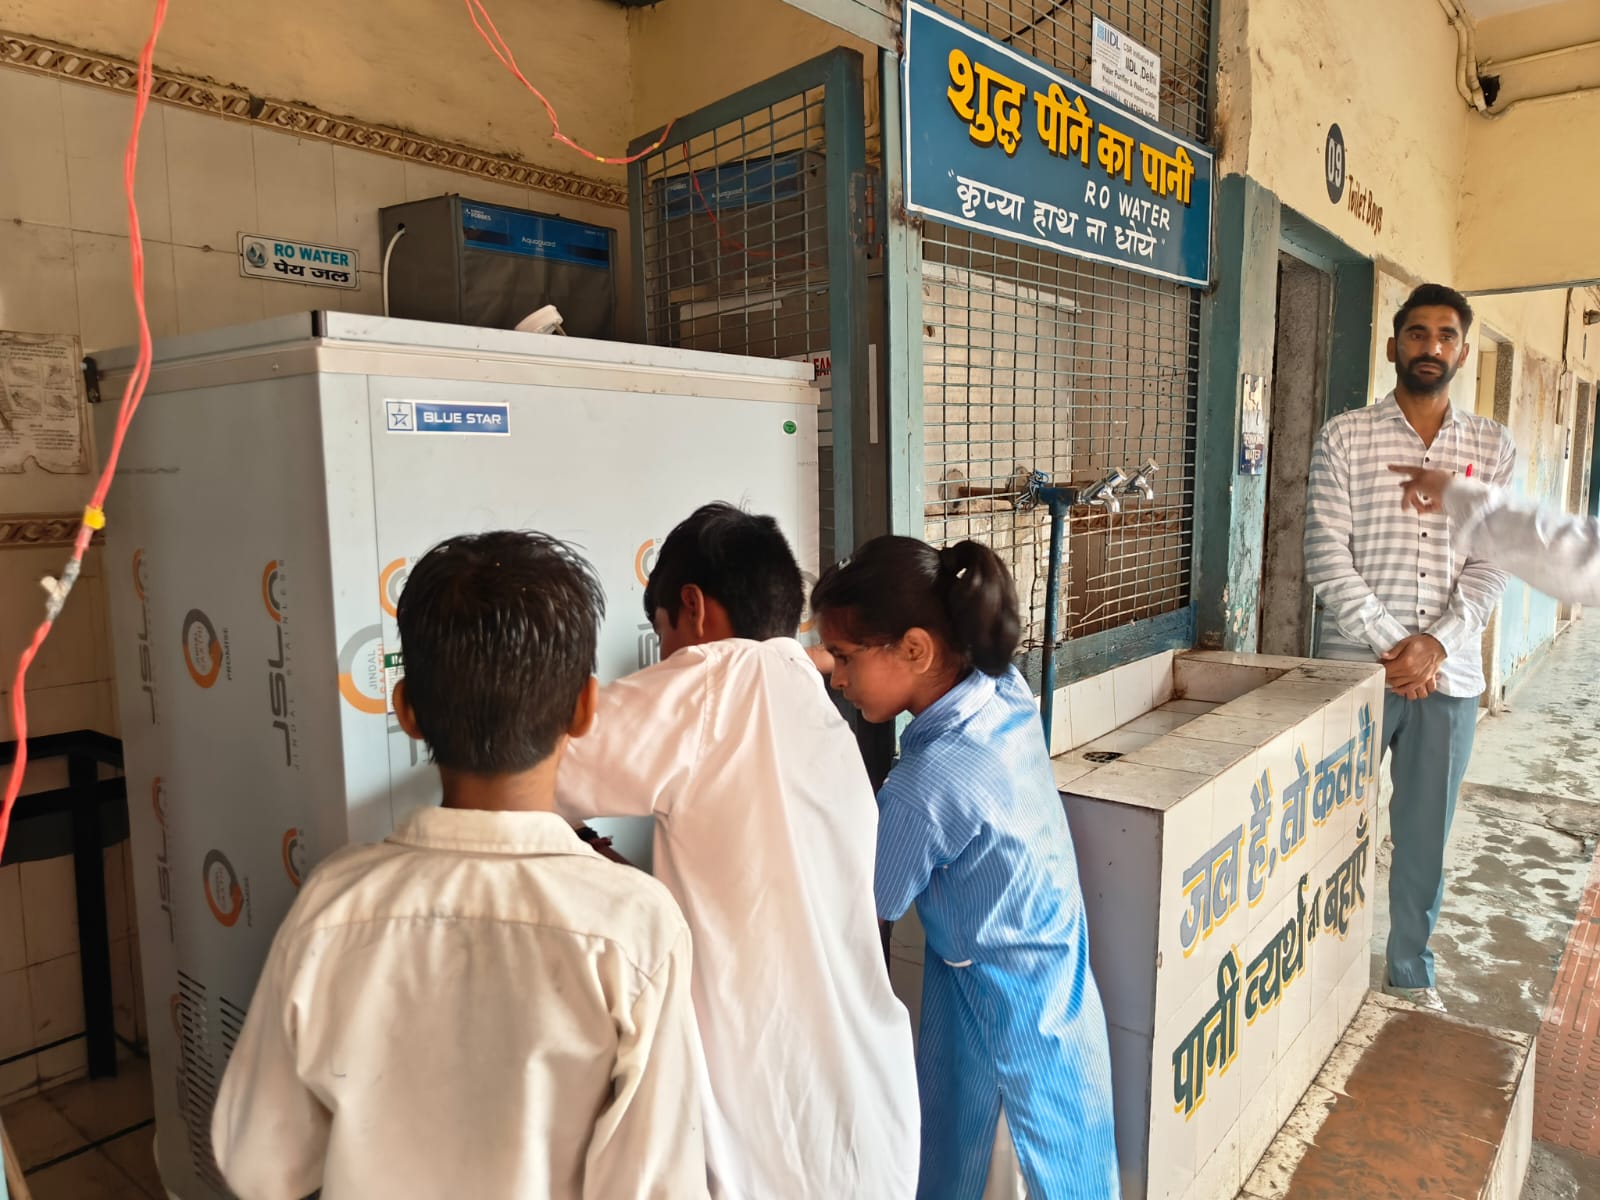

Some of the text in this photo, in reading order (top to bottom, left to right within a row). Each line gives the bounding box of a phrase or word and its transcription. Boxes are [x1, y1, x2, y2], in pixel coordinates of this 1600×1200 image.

[1104, 27, 1120, 50] IIDL
[1125, 56, 1157, 86] IIDL Delhi
[1033, 83, 1094, 165] पीने
[1097, 123, 1135, 181] का
[1140, 146, 1195, 204] पानी
[1327, 138, 1343, 188] 09
[1033, 200, 1079, 238] हाथ
[1086, 217, 1108, 246] ना
[1084, 180, 1170, 231] RO WATER
[1347, 174, 1383, 236] Toilet Boys
[273, 243, 349, 267] RO WATER
[521, 236, 556, 248] Aquaguard
[273, 259, 351, 283] पेय जल
[423, 411, 502, 425] BLUE STAR
[367, 649, 378, 691] JINDAL
[267, 623, 292, 767] JSL
[1180, 823, 1245, 956] जल
[1280, 743, 1310, 859] तो
[1312, 735, 1357, 826] कल
[1172, 946, 1242, 1119] पानी
